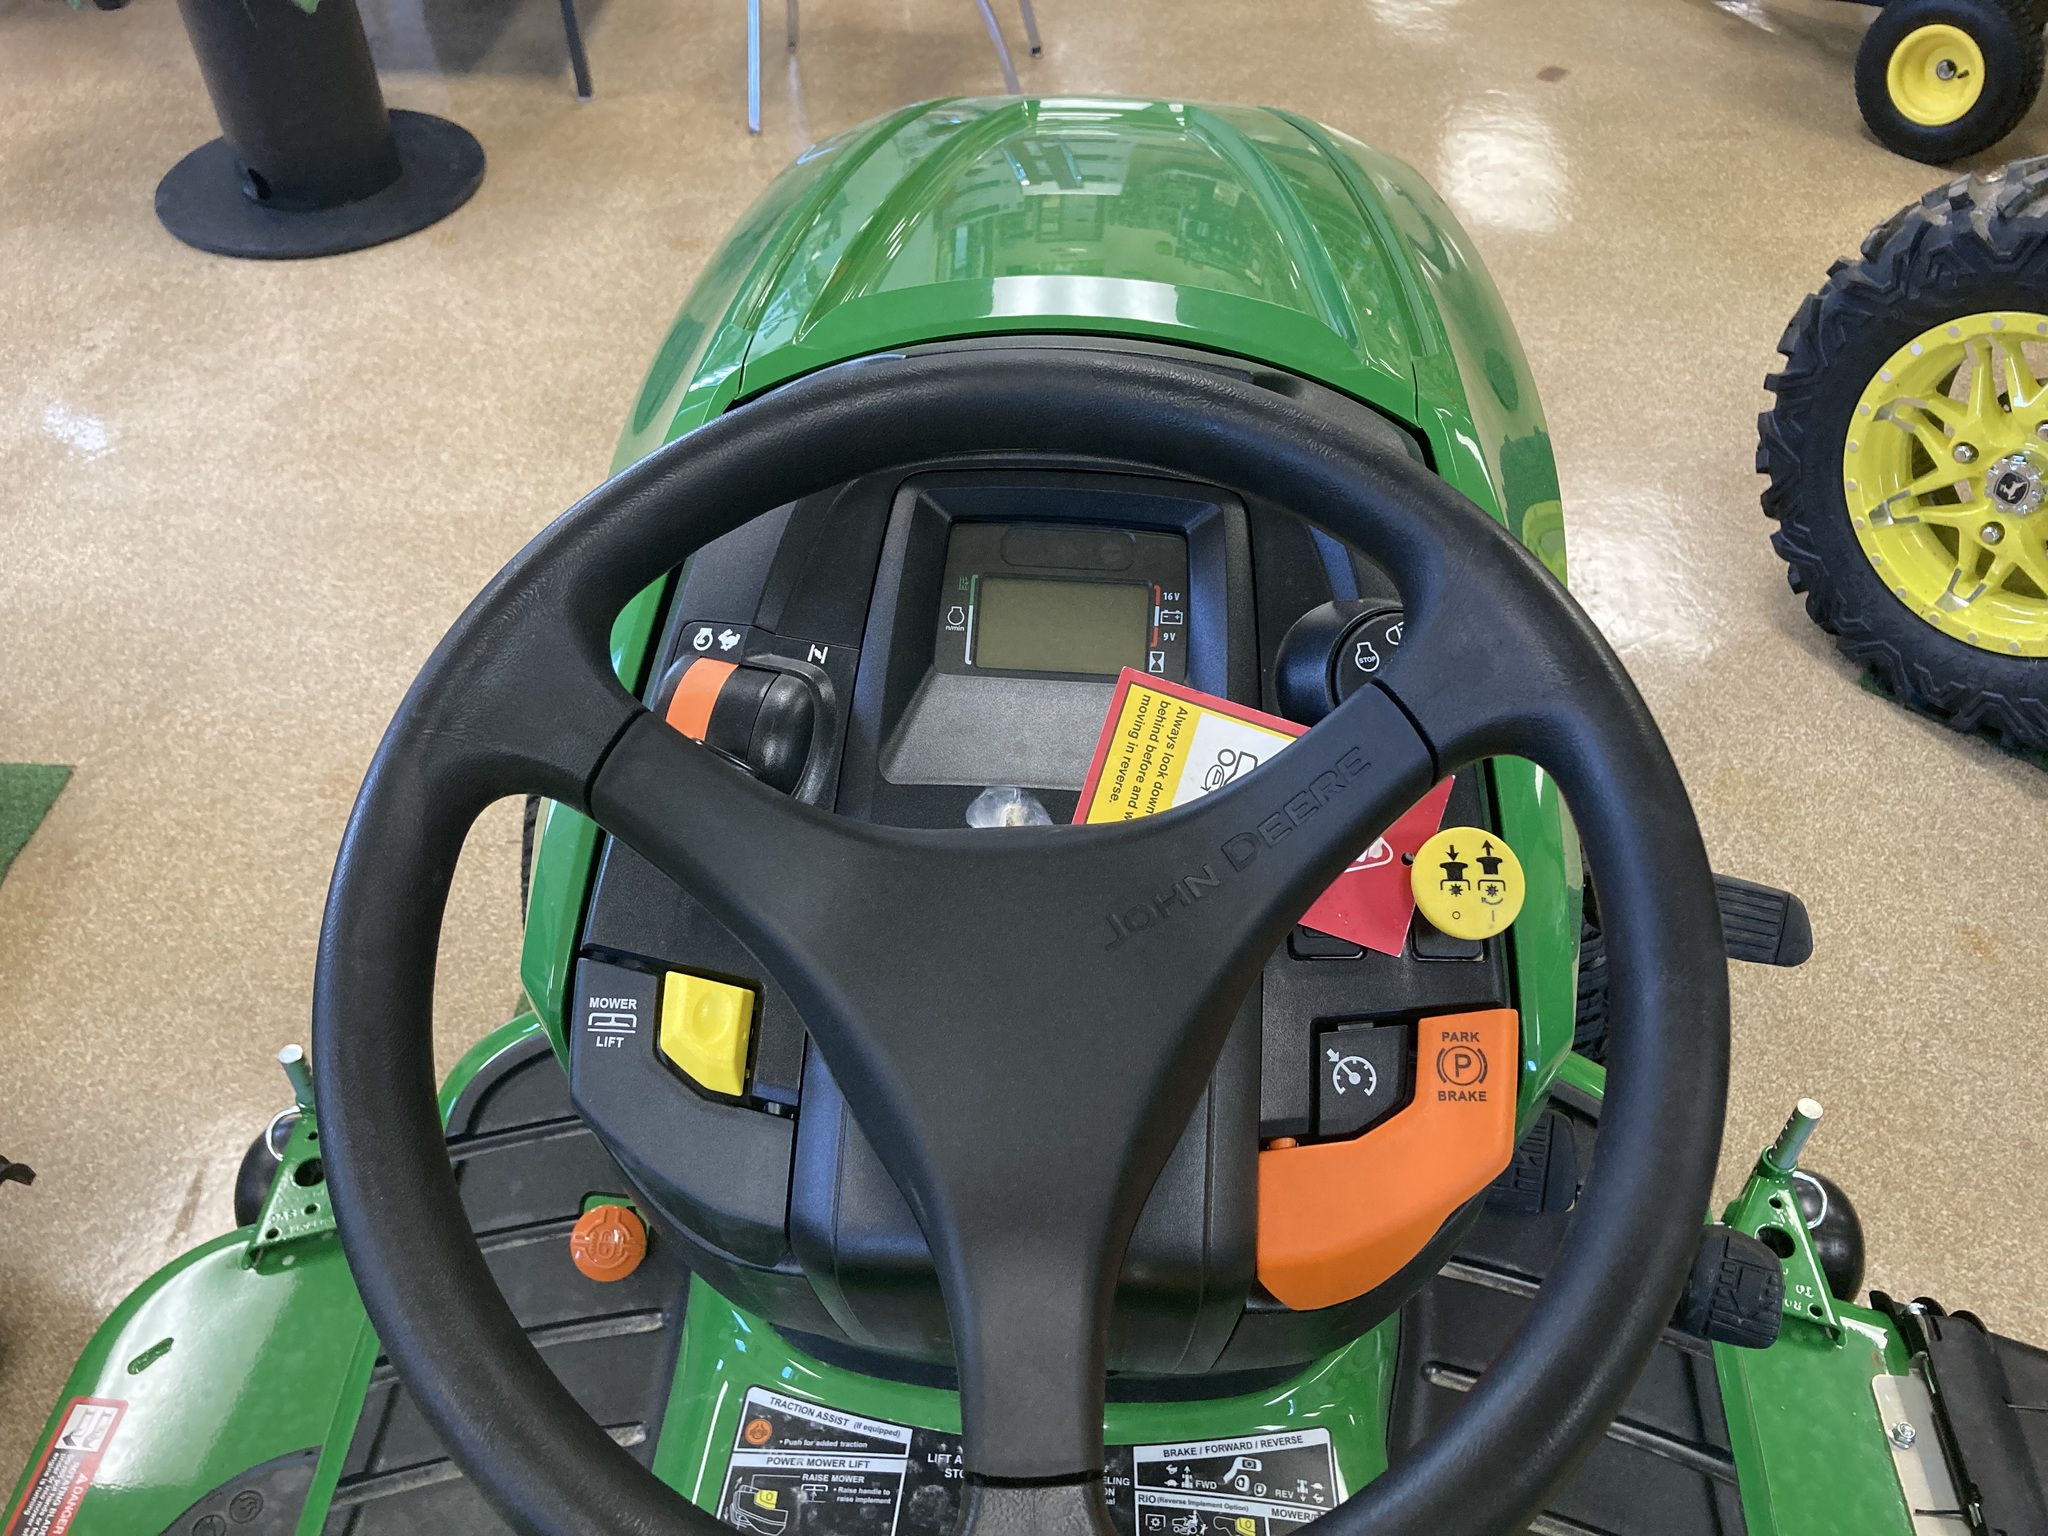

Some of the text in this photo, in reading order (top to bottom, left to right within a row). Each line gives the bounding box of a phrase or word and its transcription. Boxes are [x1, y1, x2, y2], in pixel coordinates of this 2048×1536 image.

[1163, 592, 1180, 601] 16 V
[1163, 632, 1176, 641] 9 V
[1358, 655, 1377, 664] STOP
[1149, 700, 1171, 744] behind
[1108, 694, 1151, 803] moving in reverse.
[1137, 744, 1157, 784] before
[1145, 706, 1189, 815] Always look down
[1127, 785, 1142, 809] and
[1105, 746, 1372, 951] JOHN DEERE
[589, 997, 637, 1010] MOWER
[596, 1036, 624, 1048] LIFT
[1442, 1032, 1480, 1042] PARK
[1454, 1053, 1472, 1078] P
[1438, 1090, 1487, 1102] BRAKE
[770, 1397, 815, 1416] TRACTION
[815, 1411, 850, 1427] ASSIST
[863, 1424, 901, 1439] equipped)
[783, 1438, 868, 1448] Push for added traction
[1163, 1447, 1198, 1458] BRAKE
[1204, 1441, 1253, 1455] FORWARD
[1260, 1435, 1303, 1448] REVERSE
[766, 1457, 871, 1469] POWER MOWER LIFT
[927, 1453, 952, 1464] LIFT
[802, 1473, 865, 1483] RAISE MOWER
[837, 1486, 857, 1494] Raise
[858, 1487, 881, 1495] handle
[1195, 1479, 1217, 1490] FWD
[855, 1496, 892, 1504] implement
[1274, 1489, 1294, 1499] REV
[1138, 1494, 1249, 1512] RIO (Reverse Implement Option)
[52, 1486, 84, 1535] DANGER
[1271, 1508, 1318, 1521] MOWER/
